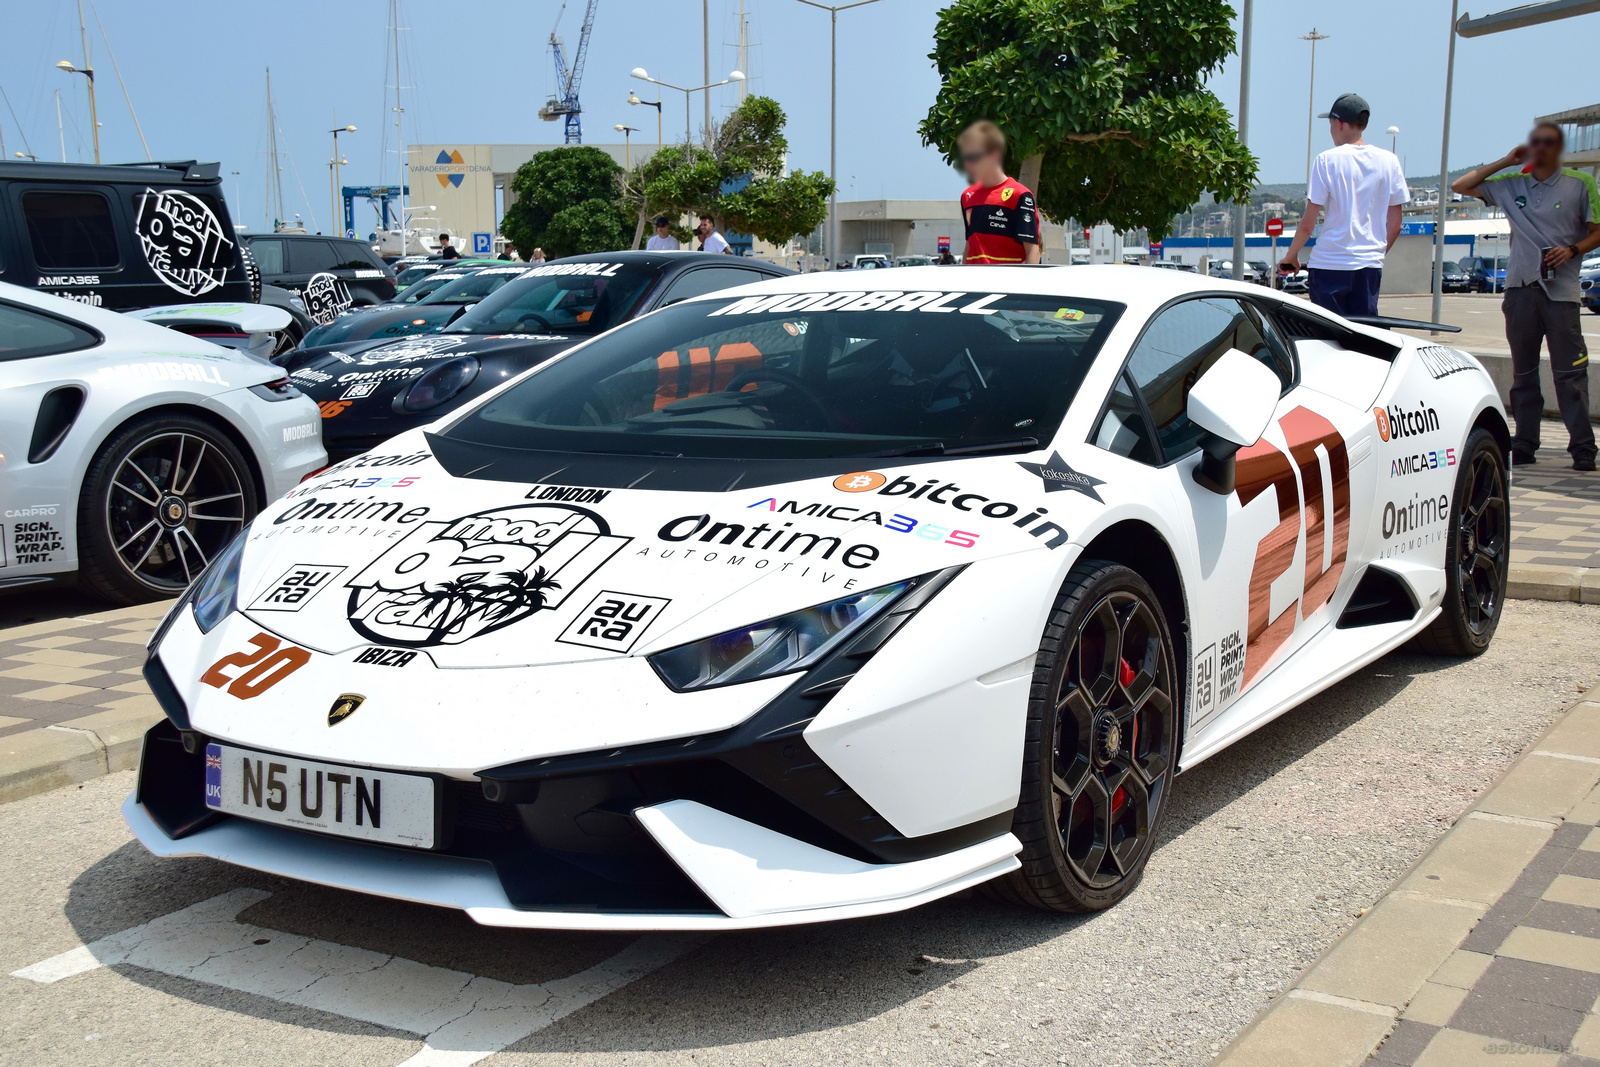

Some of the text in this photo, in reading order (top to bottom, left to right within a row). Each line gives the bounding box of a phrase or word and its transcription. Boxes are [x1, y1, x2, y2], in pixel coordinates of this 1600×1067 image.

[410, 165, 491, 173] VARADEROPORTDENIA
[38, 276, 100, 286] AMICA365
[518, 262, 624, 280] MODBALL
[309, 275, 334, 296] mod
[302, 279, 354, 318] ball
[706, 290, 1008, 318] MODBALL
[338, 367, 424, 383] Ontime
[283, 421, 318, 443] MODBALL
[1387, 400, 1440, 440] bitcoin
[1039, 465, 1091, 485] kokoshka
[1391, 447, 1457, 479] AMICA365
[280, 476, 422, 500] AMICA365
[524, 485, 612, 504] LONDON
[5, 507, 57, 518] CARPRO
[273, 495, 431, 525] Ontime
[745, 496, 981, 549] AMICA365
[876, 475, 1069, 551] bitcoin
[1382, 492, 1449, 540] Ontime
[14, 521, 54, 533] SIGN.
[15, 531, 63, 543] PRINT.
[250, 525, 402, 542] AUTOMOTIVE
[15, 541, 65, 554] WRAP.
[657, 513, 881, 570] Ontime
[1235, 404, 1351, 697] 20
[1379, 528, 1448, 560] AUTOMOTIVE
[16, 552, 53, 565] TINT.
[635, 546, 859, 591] AUTOMOTIVE
[1220, 629, 1241, 654] SIGN.
[198, 631, 313, 701] 20
[352, 646, 418, 668] IBIZA
[1220, 643, 1245, 671] PRINT.
[1220, 660, 1245, 688] WRAP.
[1219, 680, 1237, 705] TINT.
[206, 783, 221, 799] UK
[242, 757, 381, 829] N5 UTN
